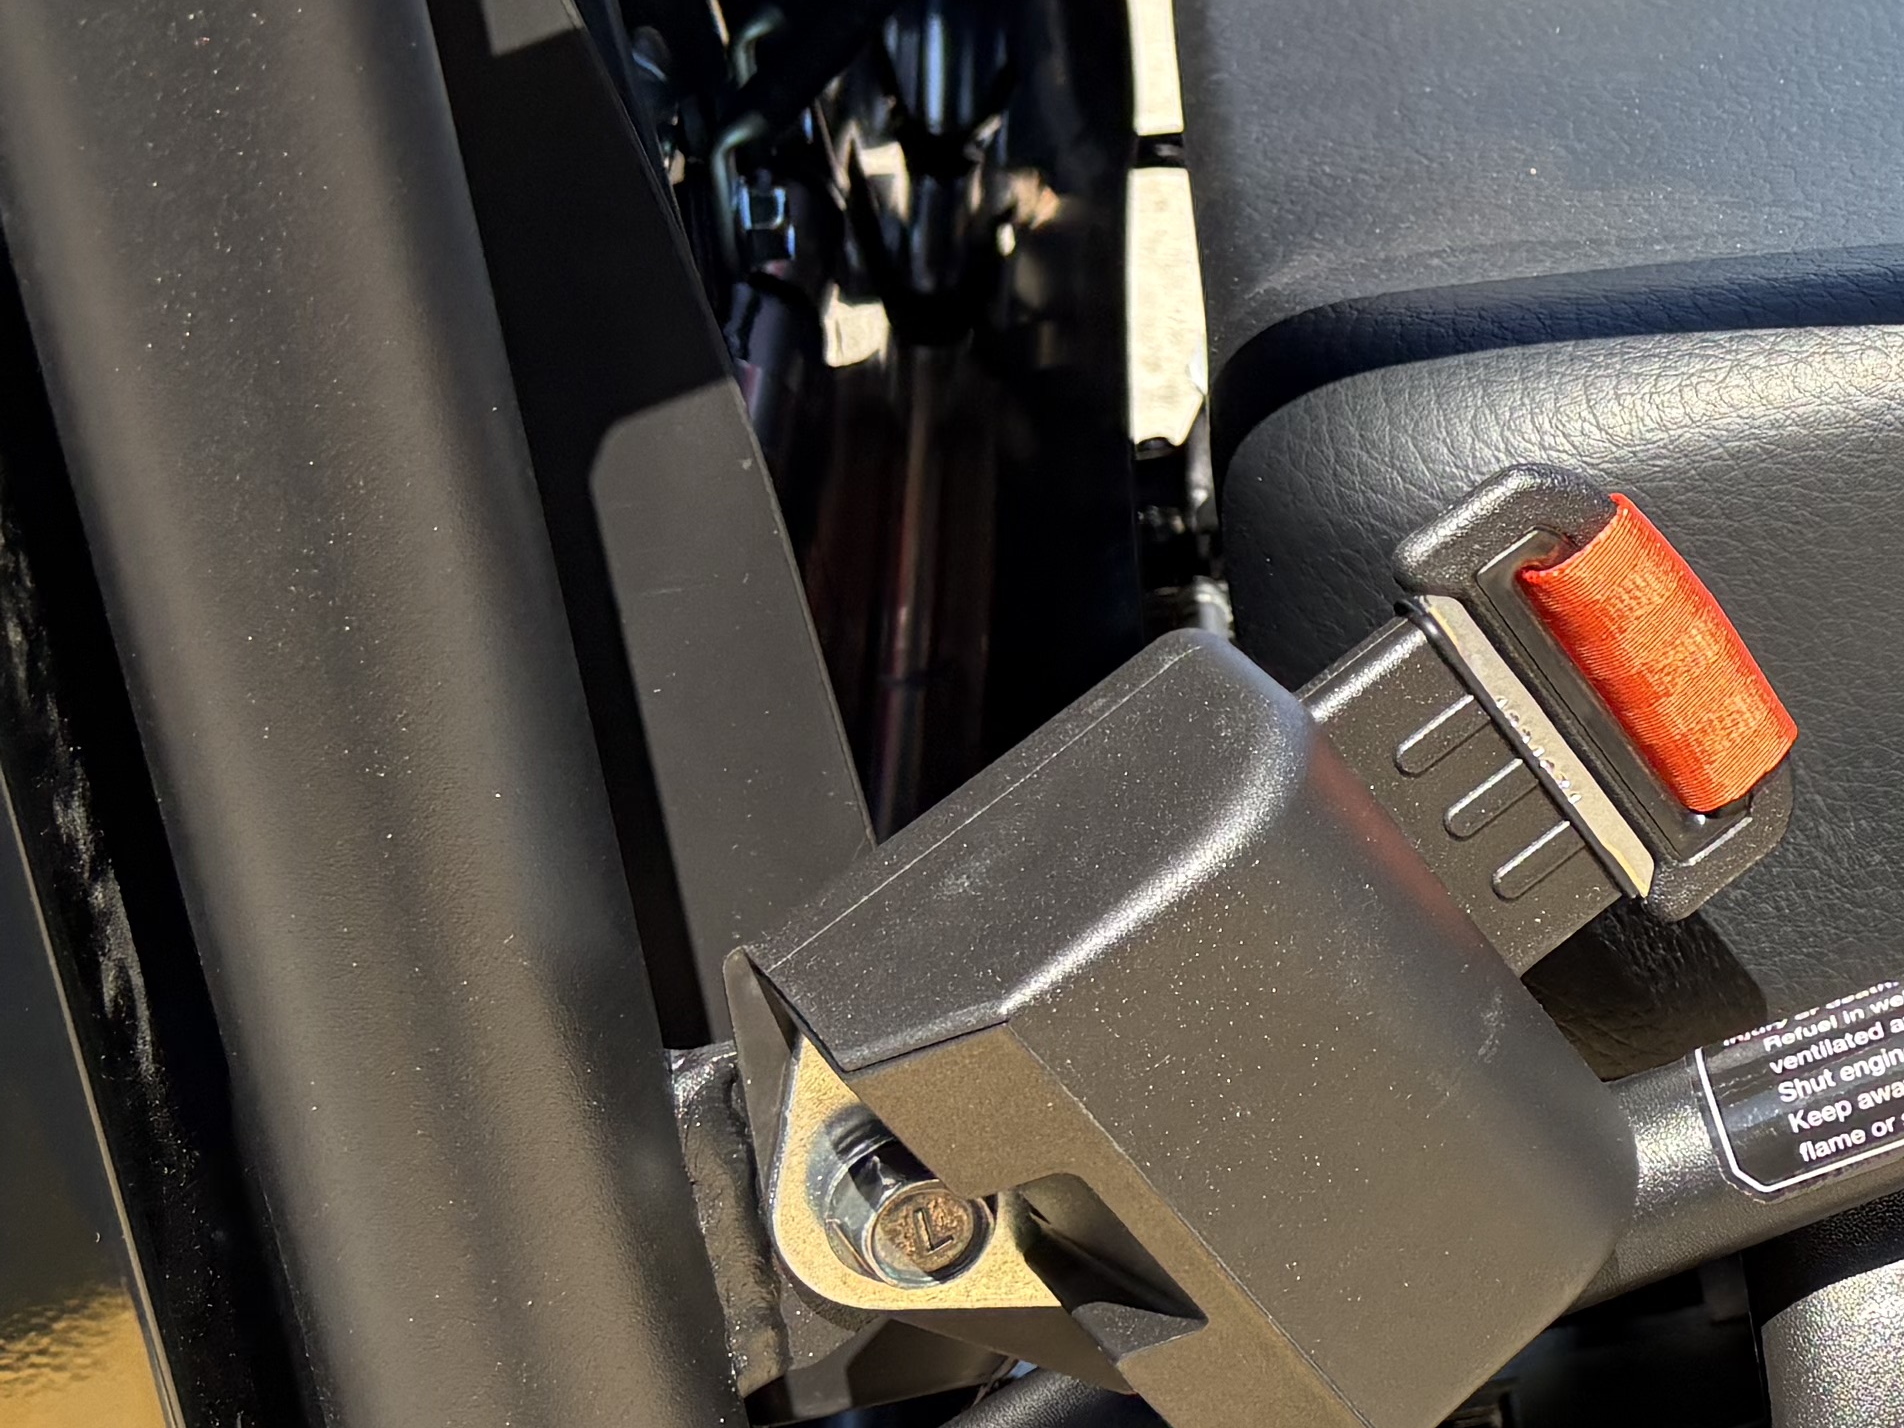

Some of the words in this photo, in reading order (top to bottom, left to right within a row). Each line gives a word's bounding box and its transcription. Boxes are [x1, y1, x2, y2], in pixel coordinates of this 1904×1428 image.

[1762, 1014, 1838, 1053] Refuel
[1841, 1002, 1865, 1025] in
[1769, 1016, 1883, 1075] ventilated
[1777, 1069, 1837, 1104] Shut
[1787, 1098, 1853, 1135] Keep
[1798, 1128, 1867, 1164] flame
[1871, 1117, 1896, 1138] or
